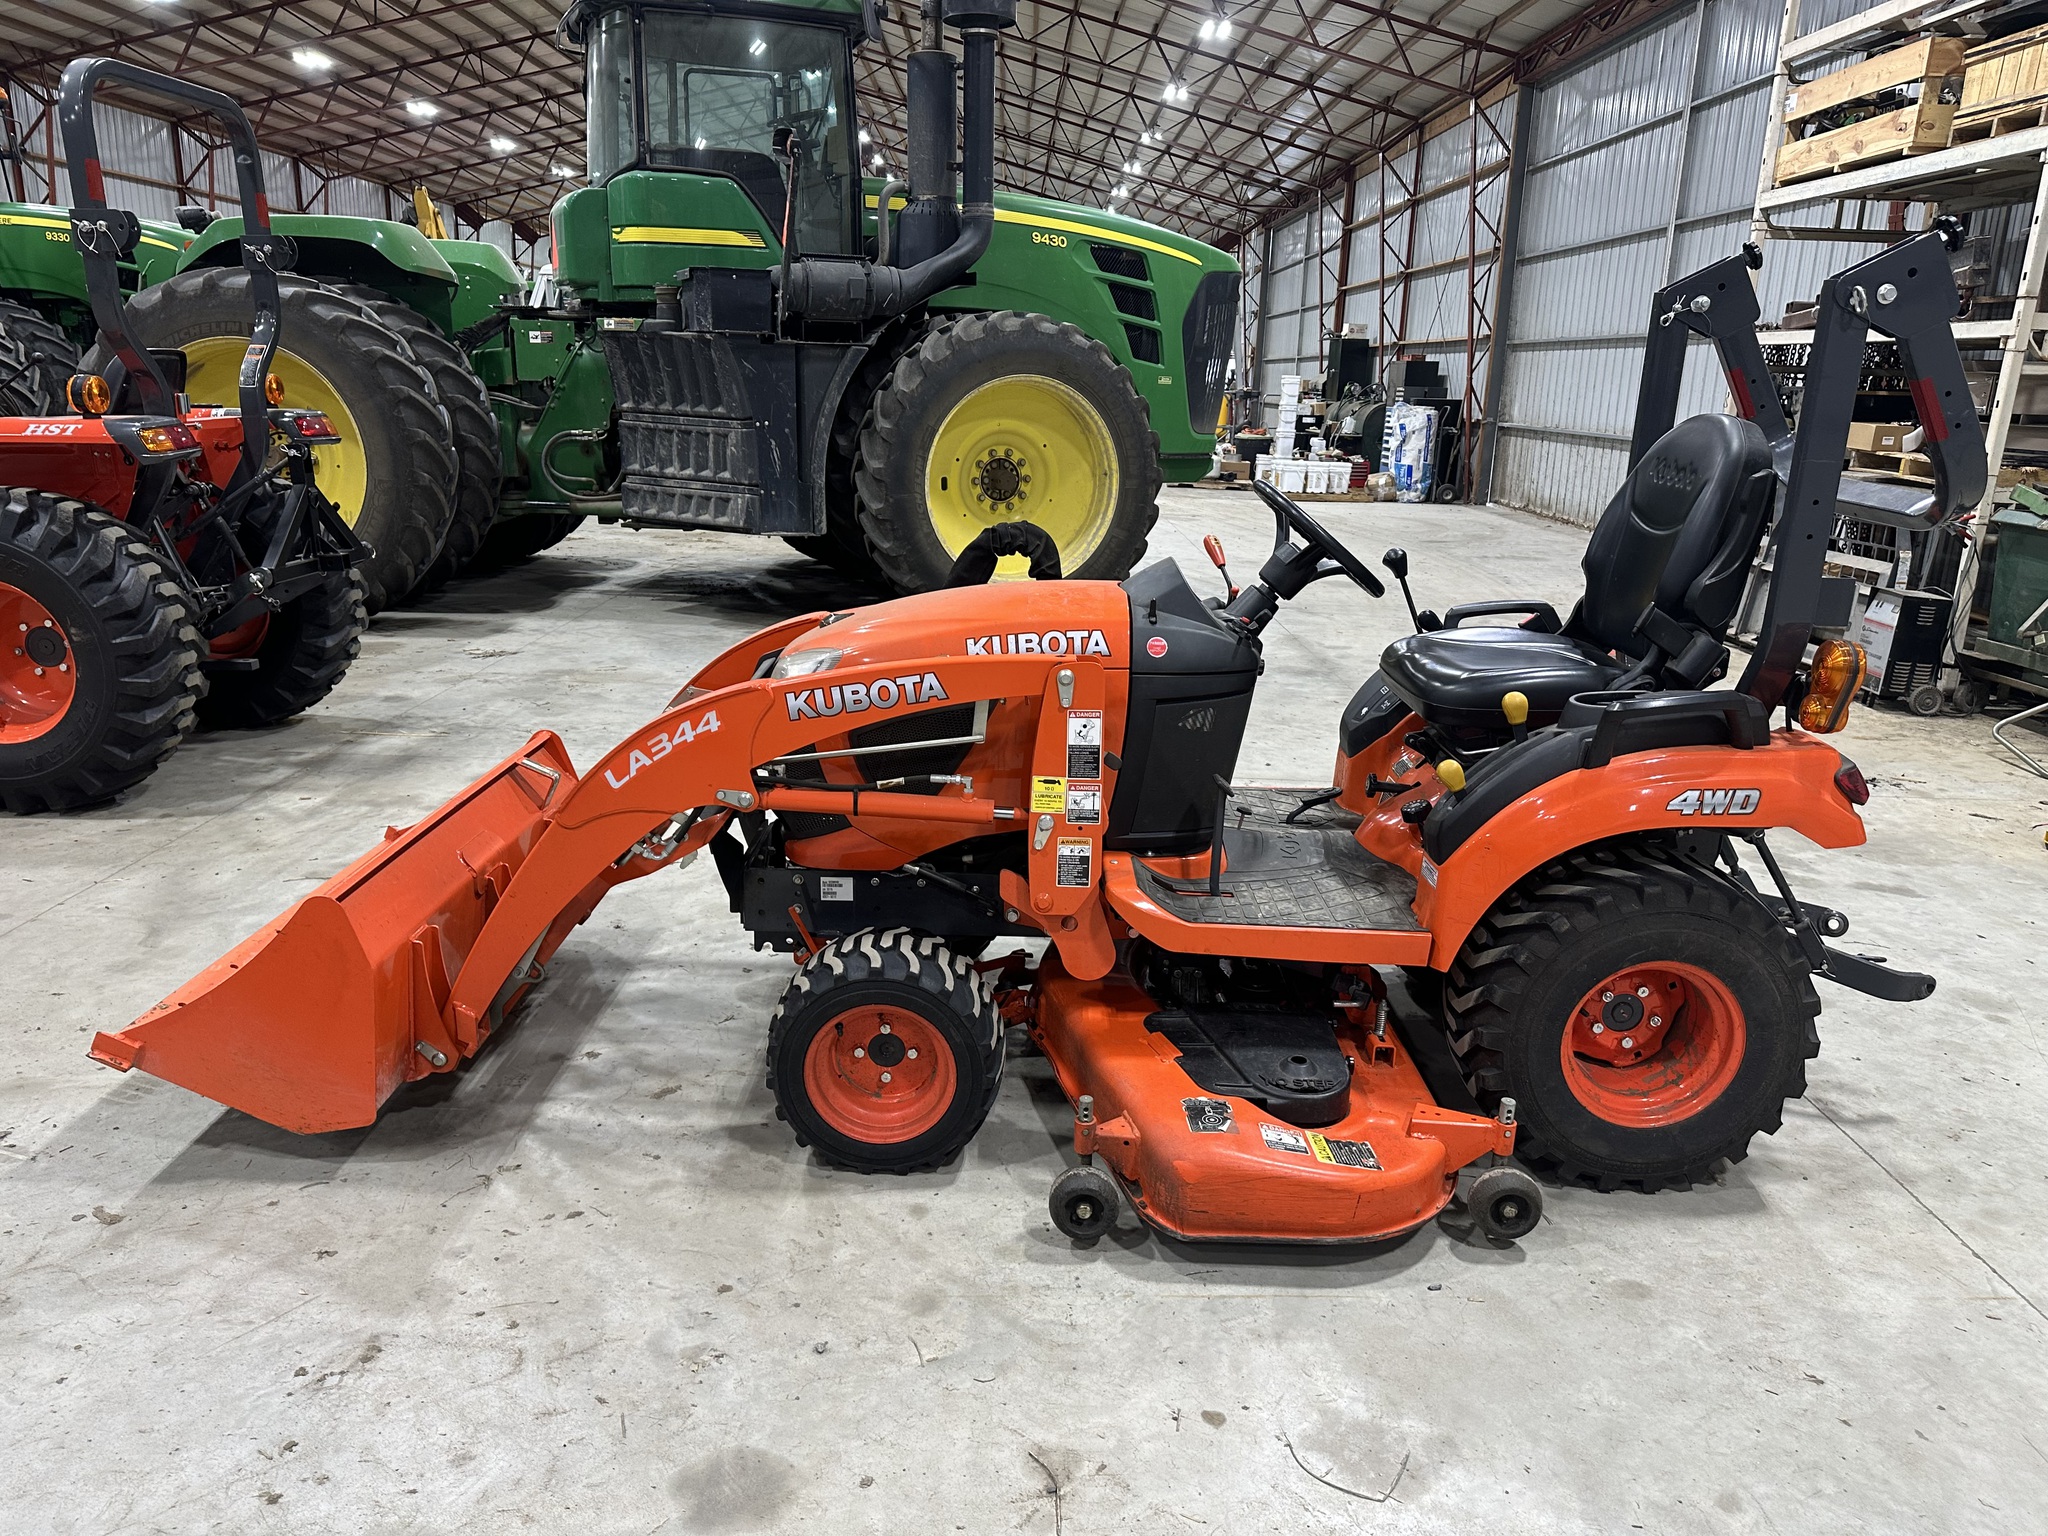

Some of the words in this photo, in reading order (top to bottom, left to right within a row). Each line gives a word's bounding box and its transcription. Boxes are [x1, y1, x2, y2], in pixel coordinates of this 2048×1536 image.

[45, 231, 70, 242] 9330
[1031, 231, 1068, 248] 9430
[23, 423, 83, 436] HST
[965, 629, 1112, 657] KUBOTA
[785, 672, 949, 722] KUBOTA
[604, 710, 721, 790] LA344
[1665, 788, 1762, 816] 4WD
